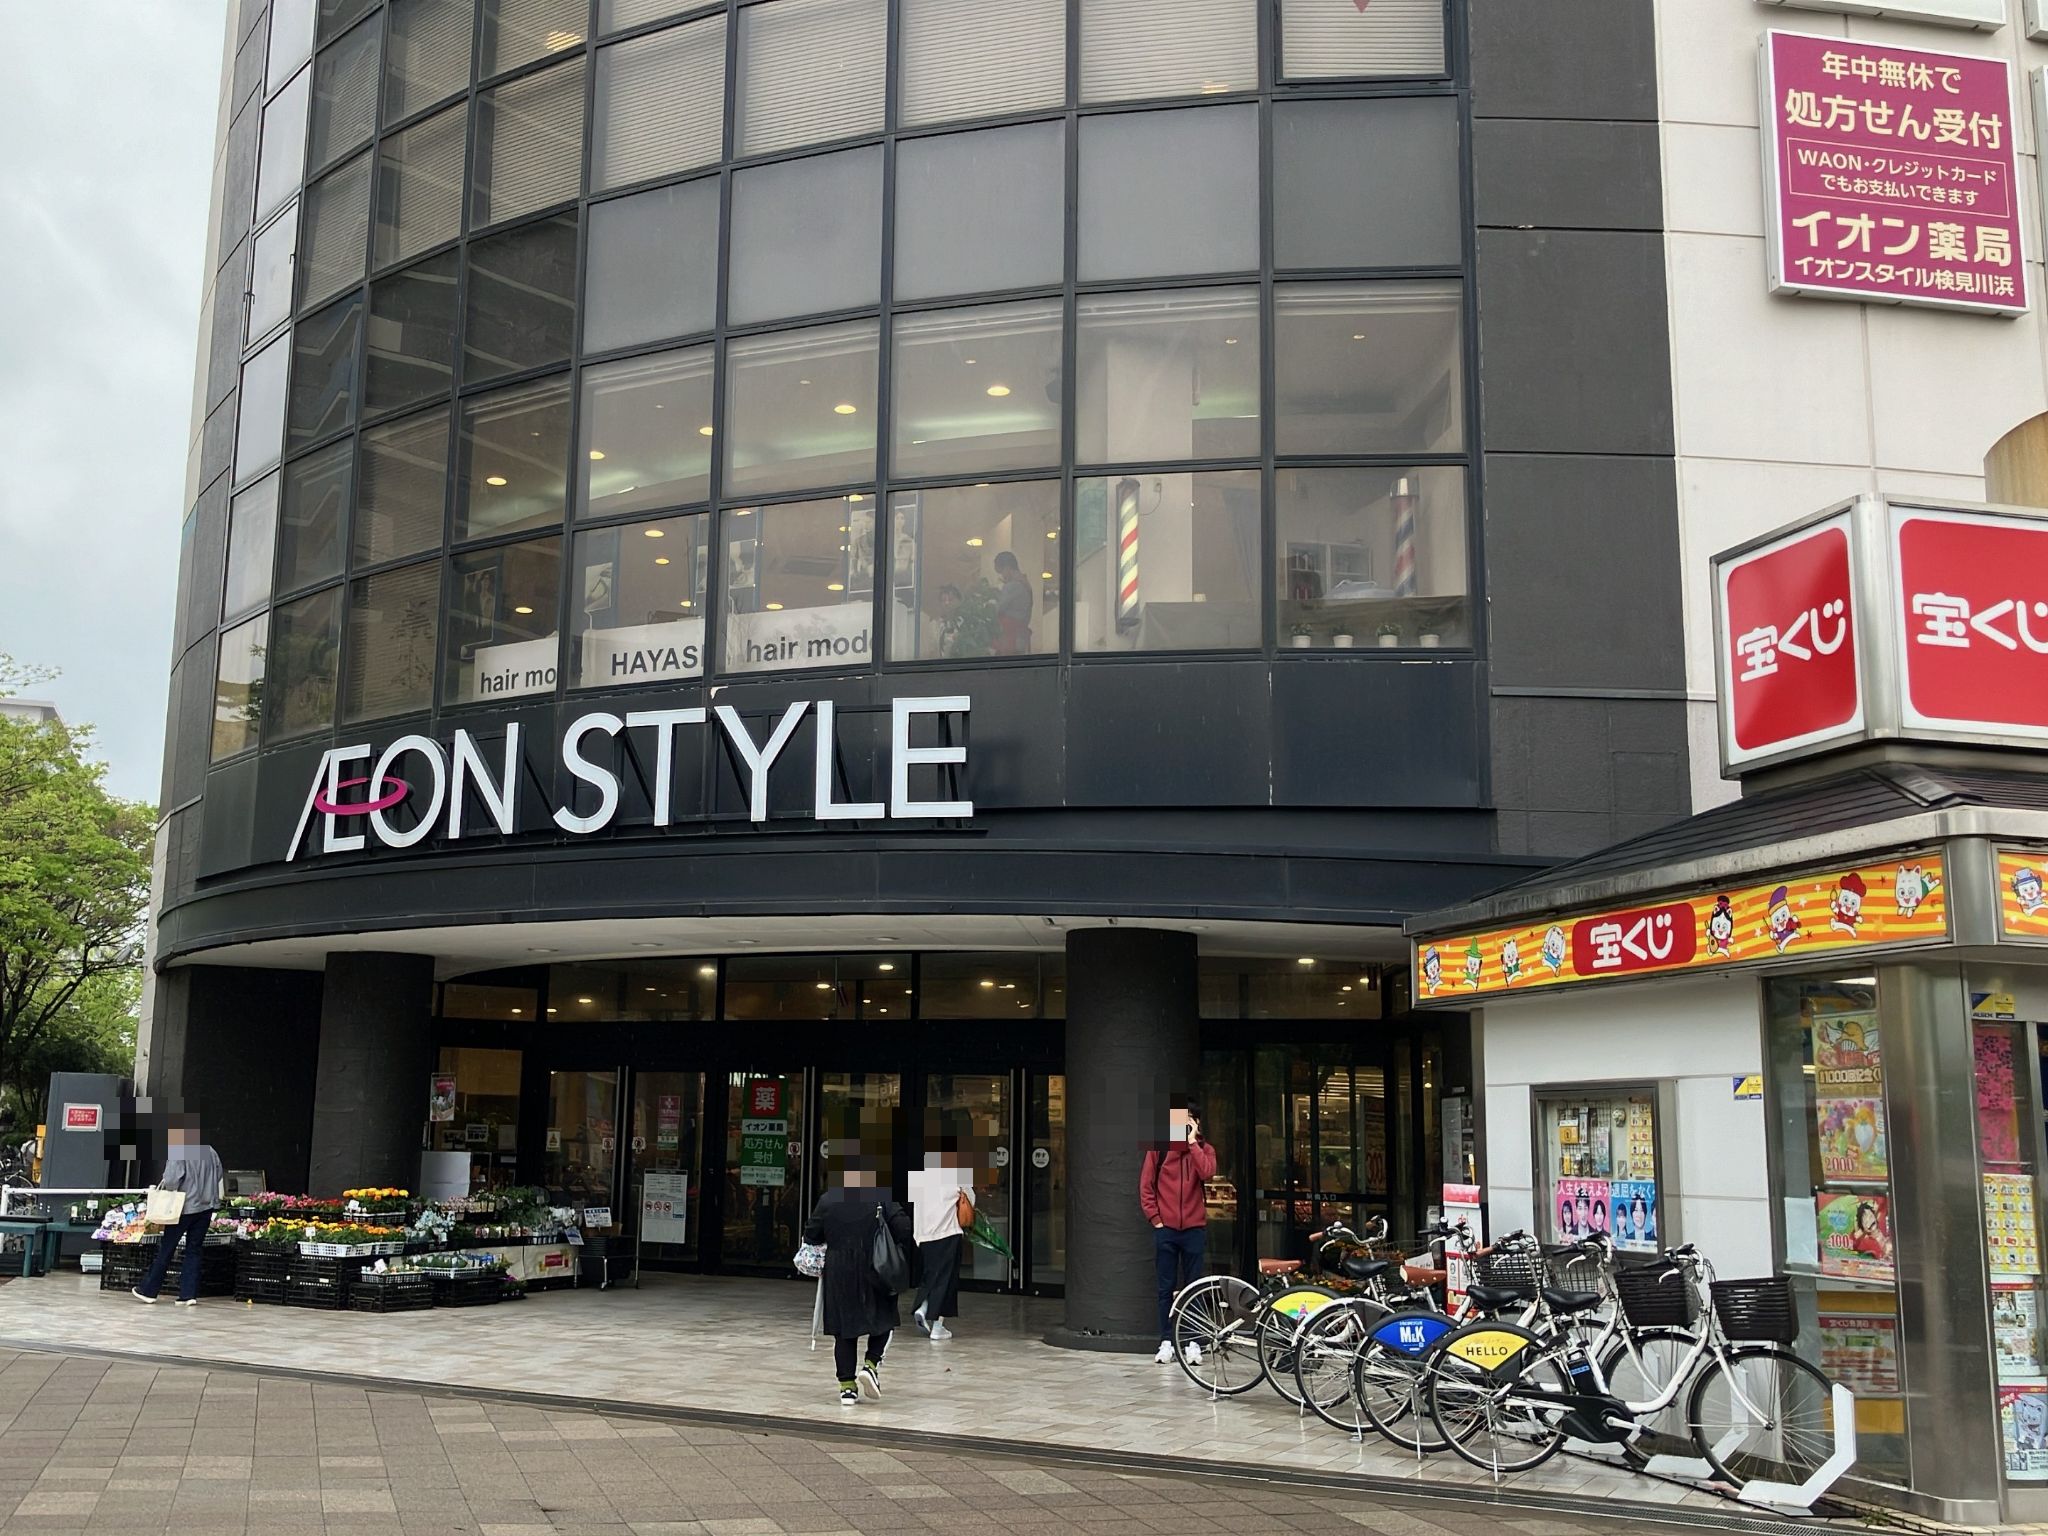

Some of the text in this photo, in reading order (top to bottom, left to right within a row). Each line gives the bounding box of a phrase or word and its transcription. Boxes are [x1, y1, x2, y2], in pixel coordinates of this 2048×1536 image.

[1821, 50, 1962, 94] 年中無休で
[1785, 88, 2003, 149] 処方せん受付
[1820, 174, 1979, 206] でもお支払いできます
[1792, 210, 2012, 267] イオン薬局
[1794, 256, 2015, 298] イオンスタイル検見川浜
[747, 628, 873, 662] hair mod
[1736, 598, 1846, 683] 宝くじ
[611, 644, 704, 677] HAYAS
[480, 668, 520, 694] hair
[552, 695, 975, 835] STYLE
[1590, 913, 1674, 969] 宝くじ
[755, 1086, 776, 1111] 薬
[743, 1137, 784, 1150] 処方せん
[752, 1151, 774, 1165] 受付
[1466, 1346, 1508, 1356] HELLO
